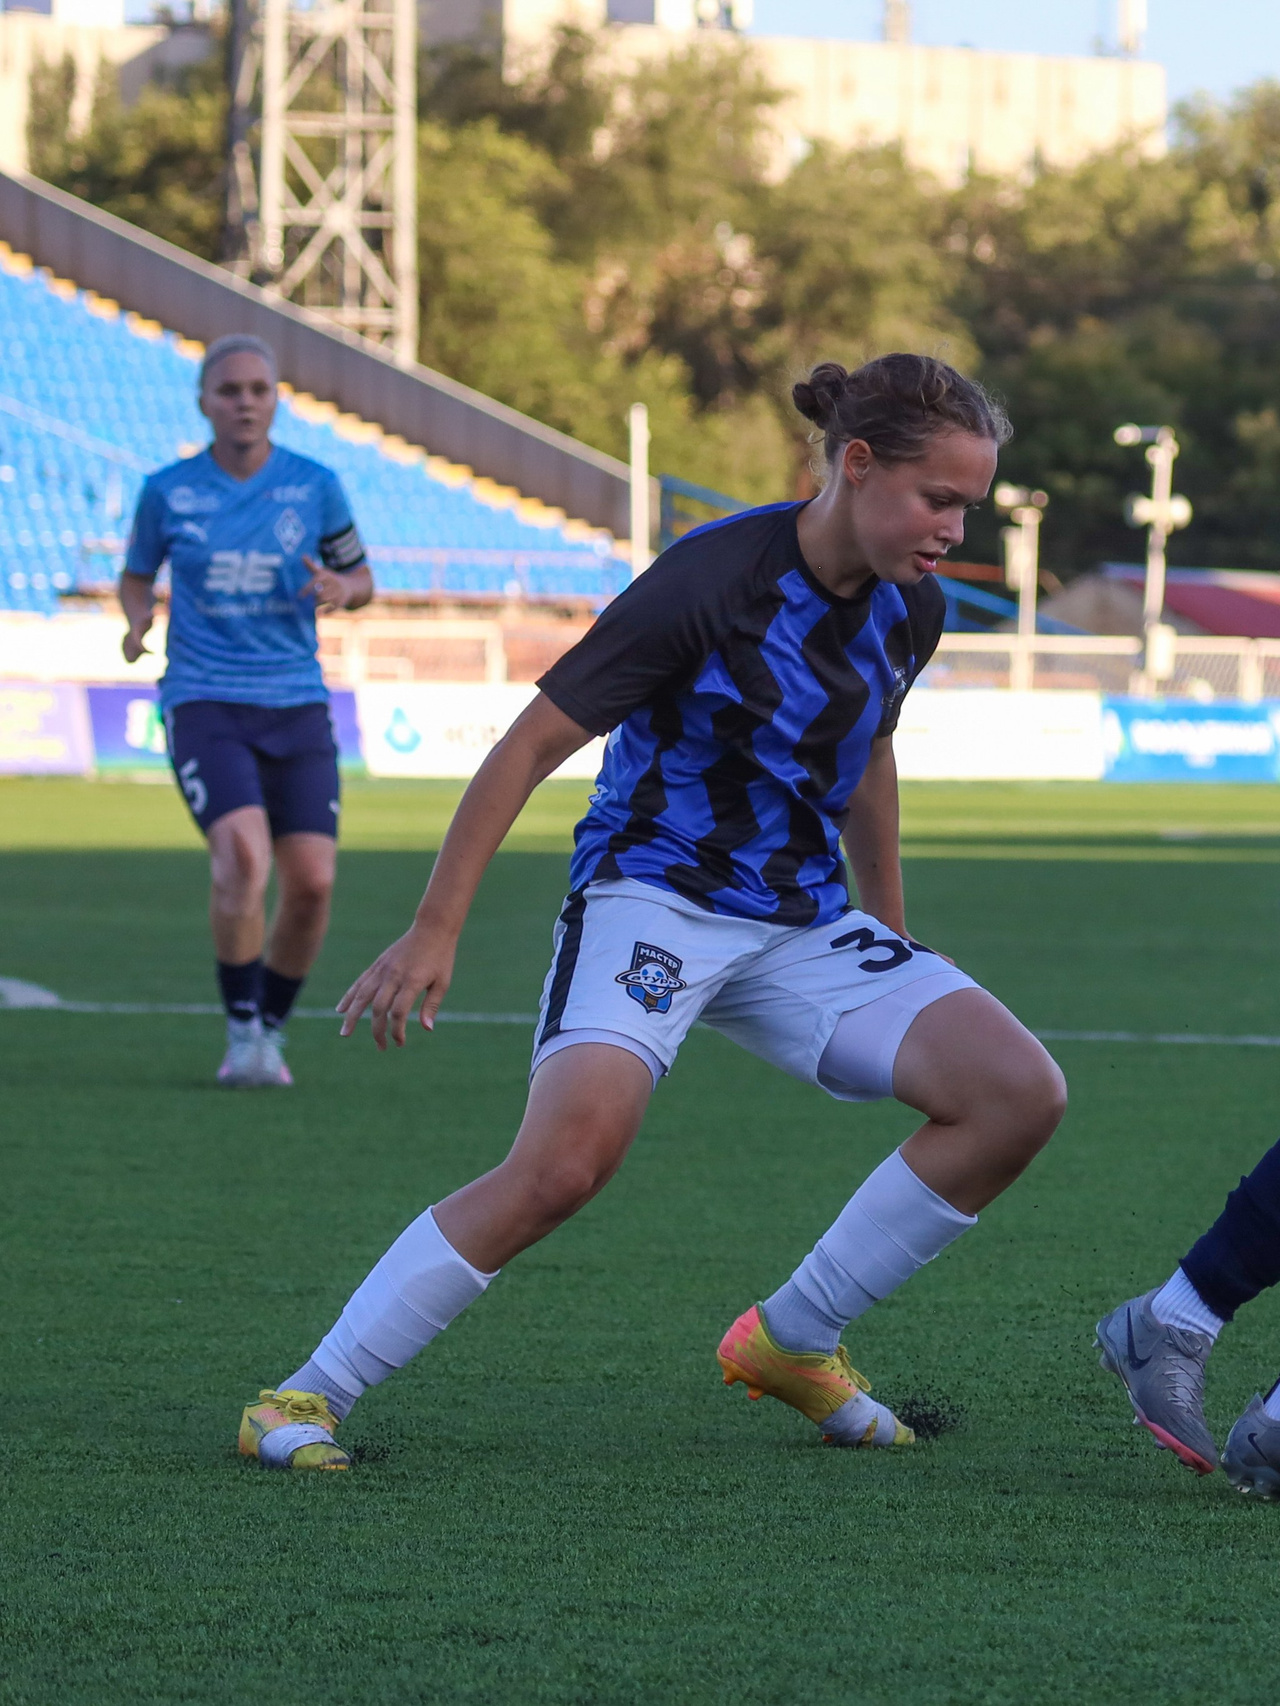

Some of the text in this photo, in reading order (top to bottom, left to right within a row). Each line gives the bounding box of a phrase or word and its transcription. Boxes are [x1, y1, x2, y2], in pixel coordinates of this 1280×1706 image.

[180, 760, 208, 814] 5
[640, 947, 678, 969] МАСТЕР
[829, 926, 938, 974] 3
